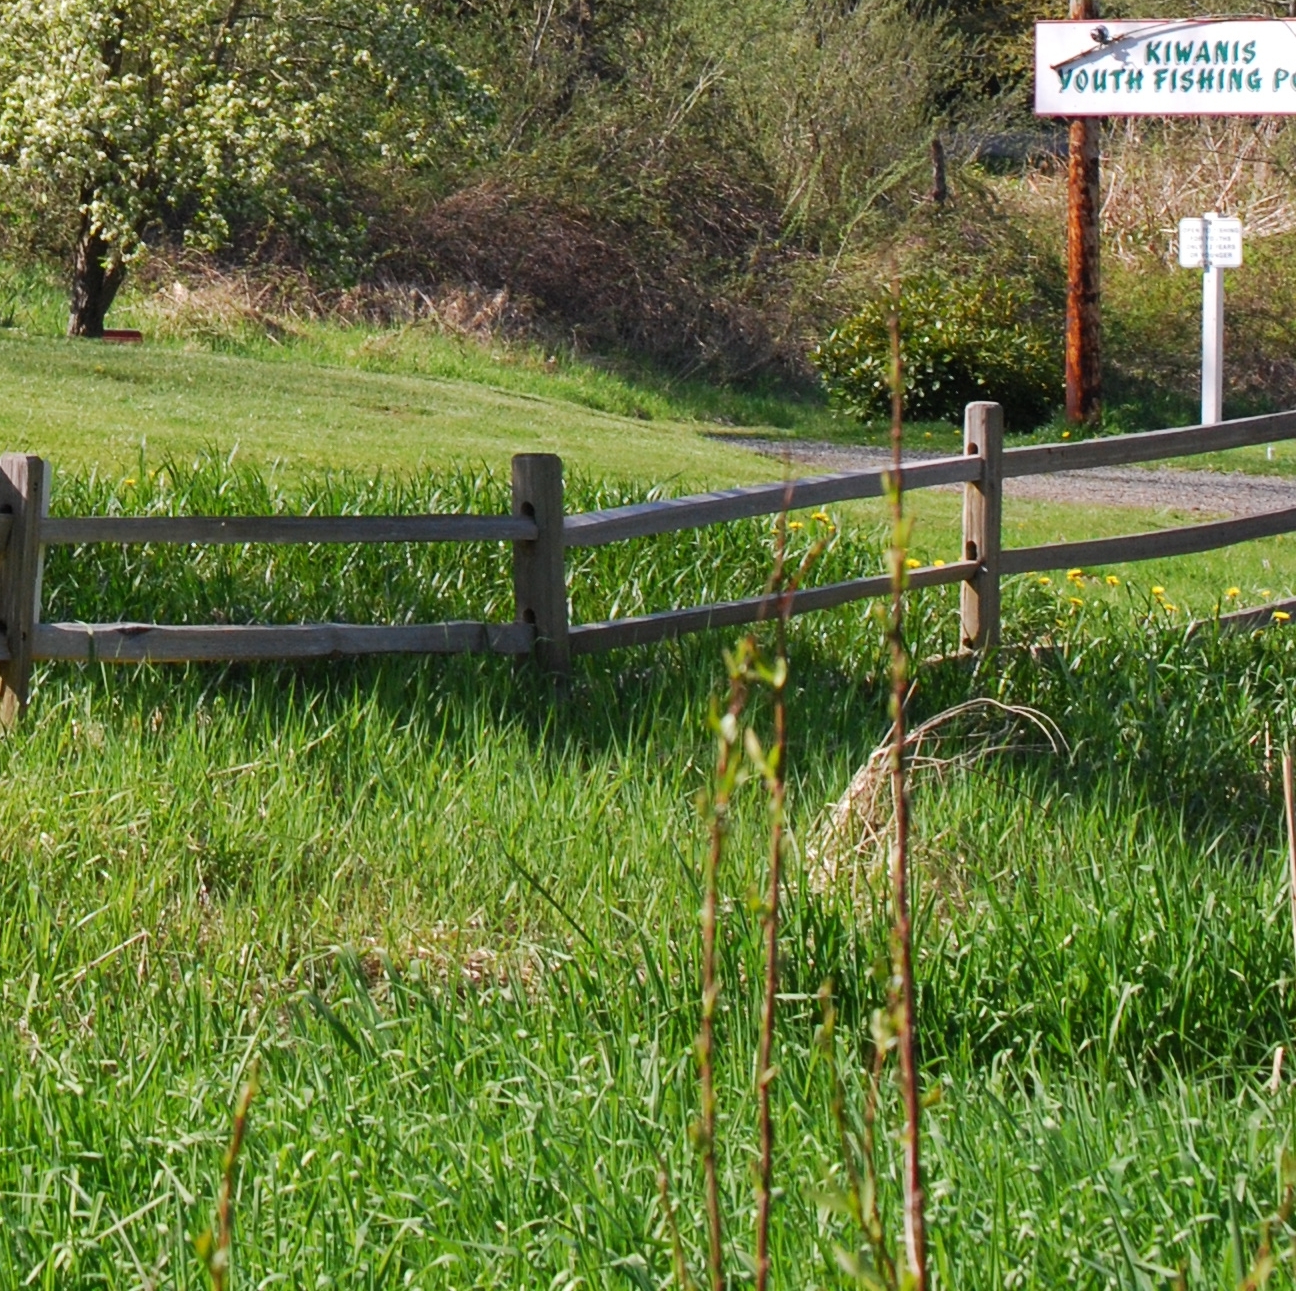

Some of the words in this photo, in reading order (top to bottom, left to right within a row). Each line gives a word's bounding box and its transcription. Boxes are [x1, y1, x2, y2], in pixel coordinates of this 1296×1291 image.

[1145, 40, 1256, 65] KIWANIS
[1058, 68, 1144, 92] YOUTH
[1154, 68, 1262, 92] FISHING
